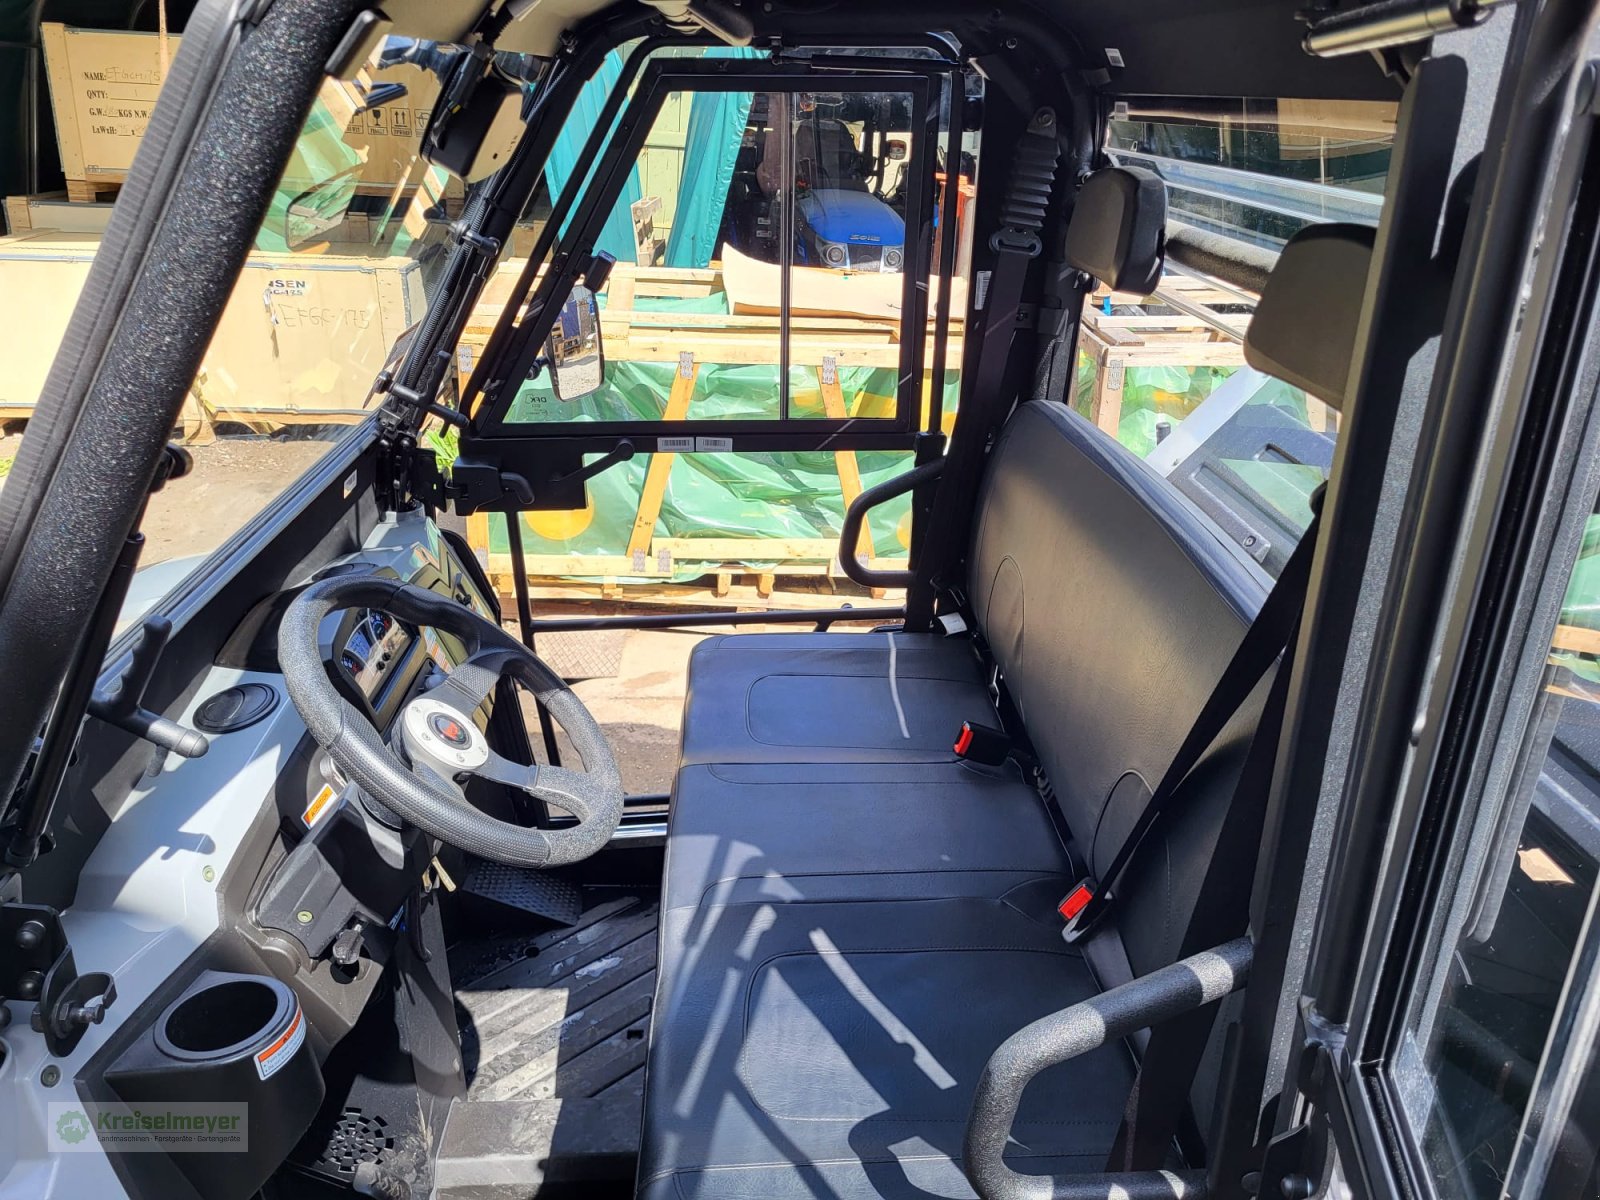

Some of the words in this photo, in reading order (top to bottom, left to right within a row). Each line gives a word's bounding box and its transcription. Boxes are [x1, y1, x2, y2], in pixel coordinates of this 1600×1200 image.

[84, 72, 107, 81] NAME:
[86, 89, 108, 99] QNTY:
[118, 109, 132, 118] KGS
